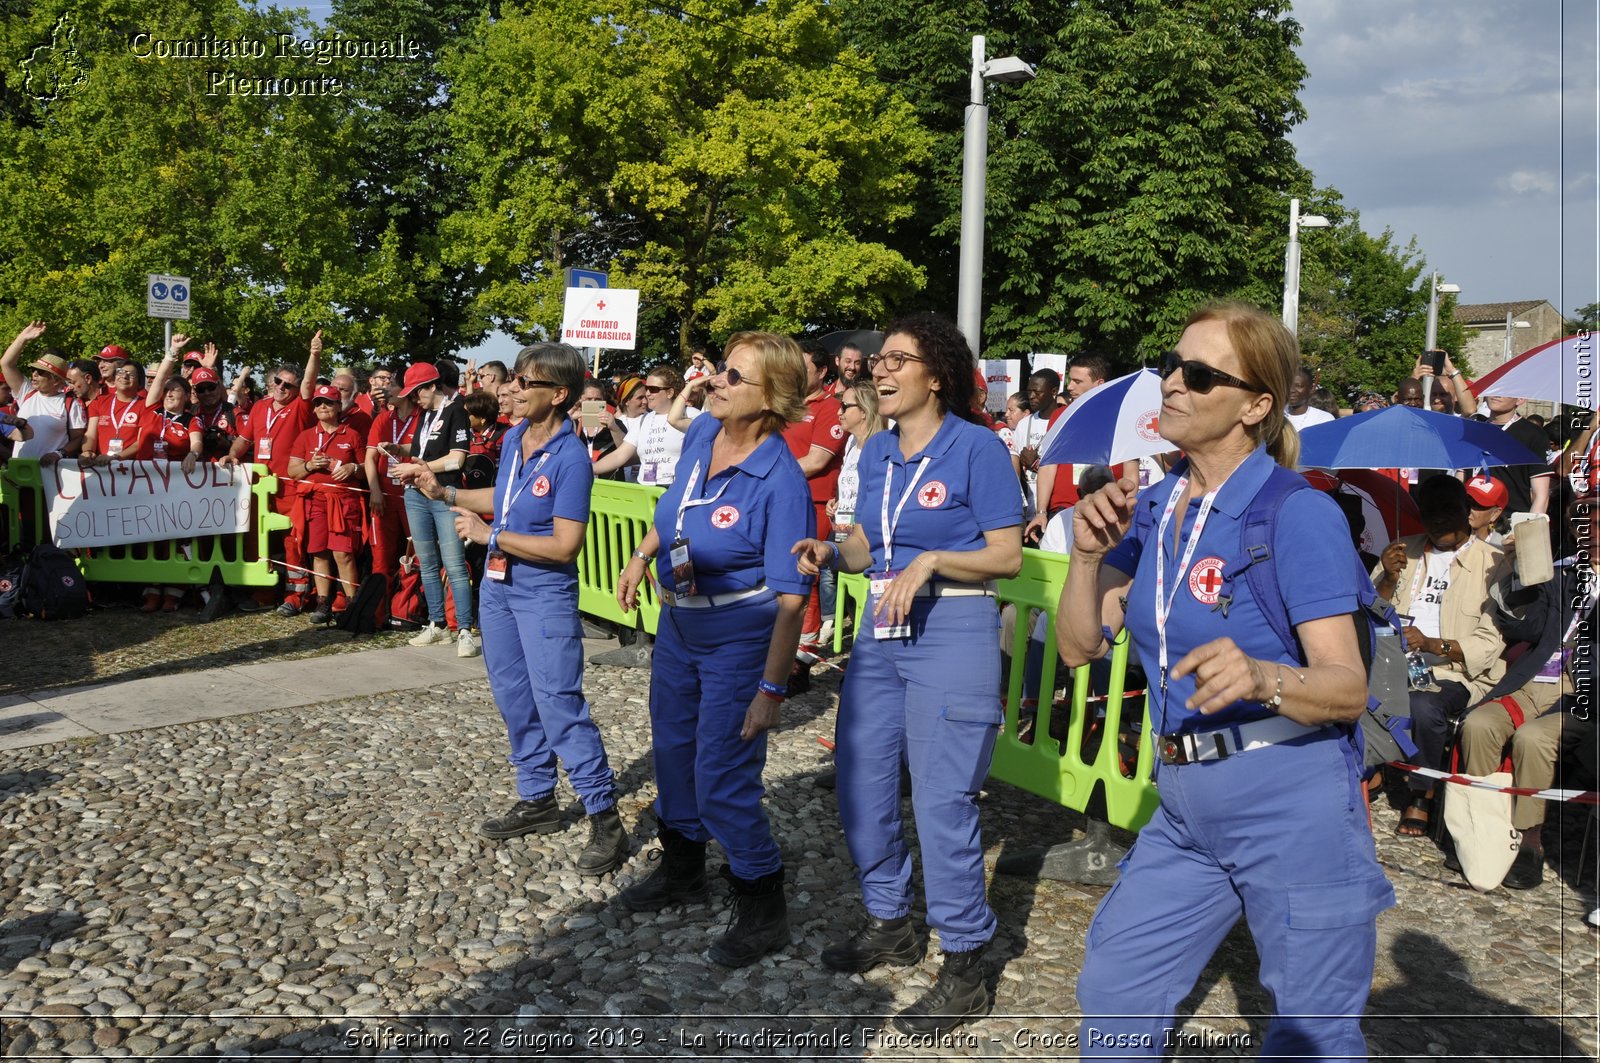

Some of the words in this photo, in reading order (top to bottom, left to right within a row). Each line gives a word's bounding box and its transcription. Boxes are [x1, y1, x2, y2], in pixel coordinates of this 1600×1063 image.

[580, 319, 619, 329] COMITATO
[565, 329, 574, 338] DI
[575, 330, 596, 339] VILLA
[597, 331, 632, 341] BASILICA
[57, 500, 193, 540] SOLFERINO
[198, 497, 250, 529] 2019
